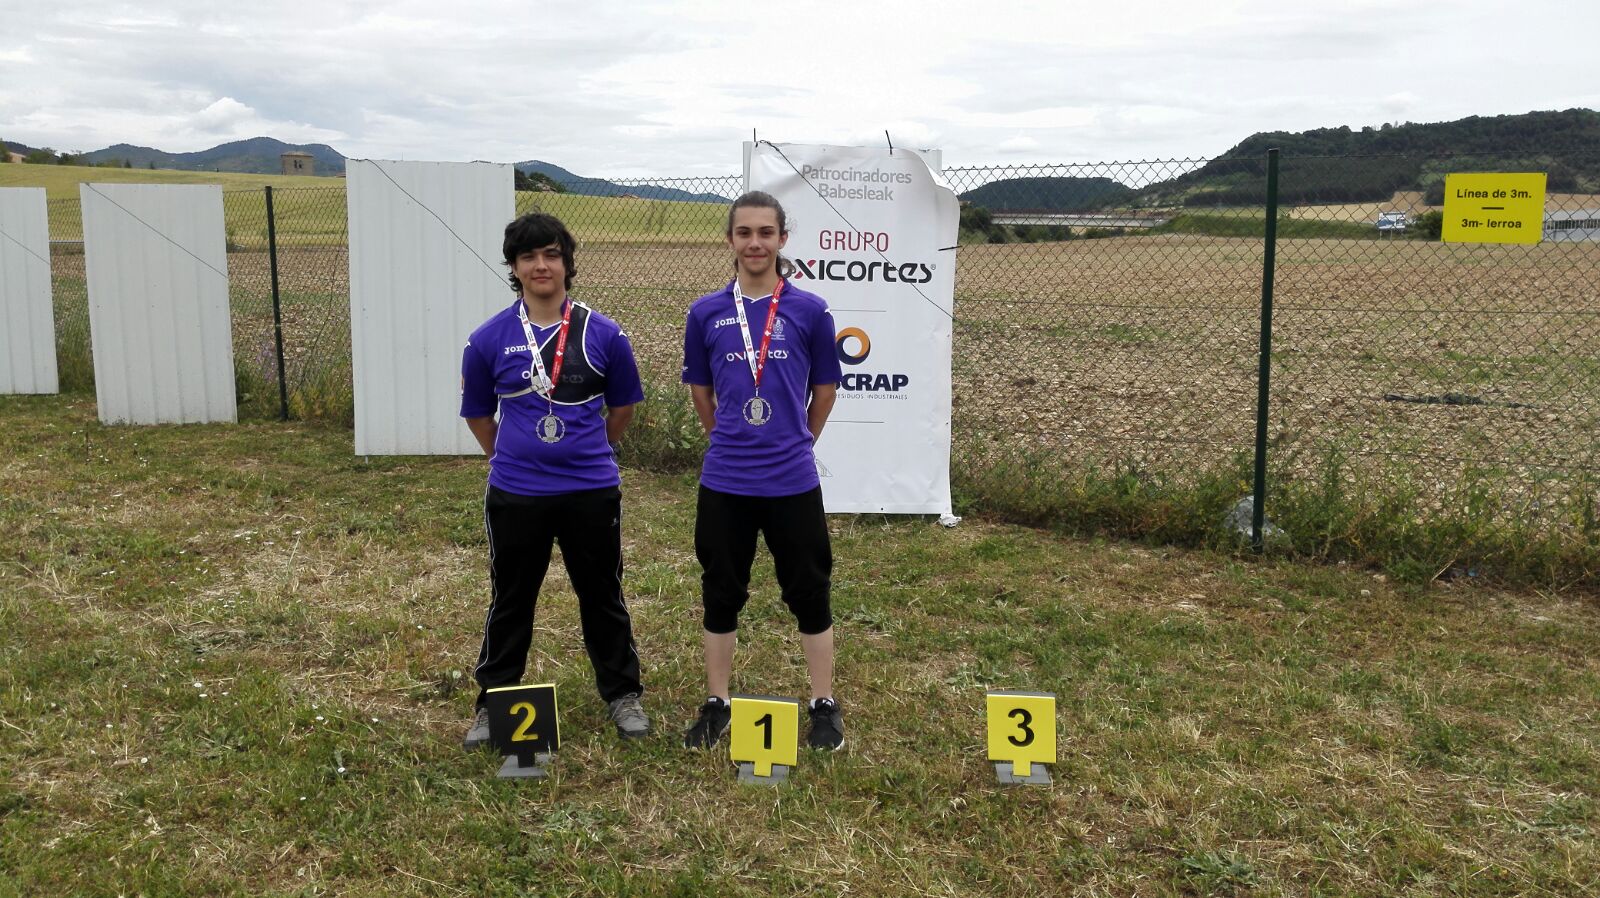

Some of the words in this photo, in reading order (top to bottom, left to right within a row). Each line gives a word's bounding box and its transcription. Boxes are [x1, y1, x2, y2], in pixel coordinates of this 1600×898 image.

[802, 164, 912, 184] Patrocinadores
[818, 183, 894, 201] Babesleak
[1457, 188, 1488, 198] Línea
[1492, 189, 1507, 198] de
[1510, 189, 1532, 198] 3m.
[1461, 219, 1483, 228] 3m-
[1487, 219, 1522, 228] lerroa
[819, 230, 889, 252] GRUPO
[509, 701, 538, 742] 2
[754, 713, 773, 750] 1
[1007, 708, 1035, 747] 3
